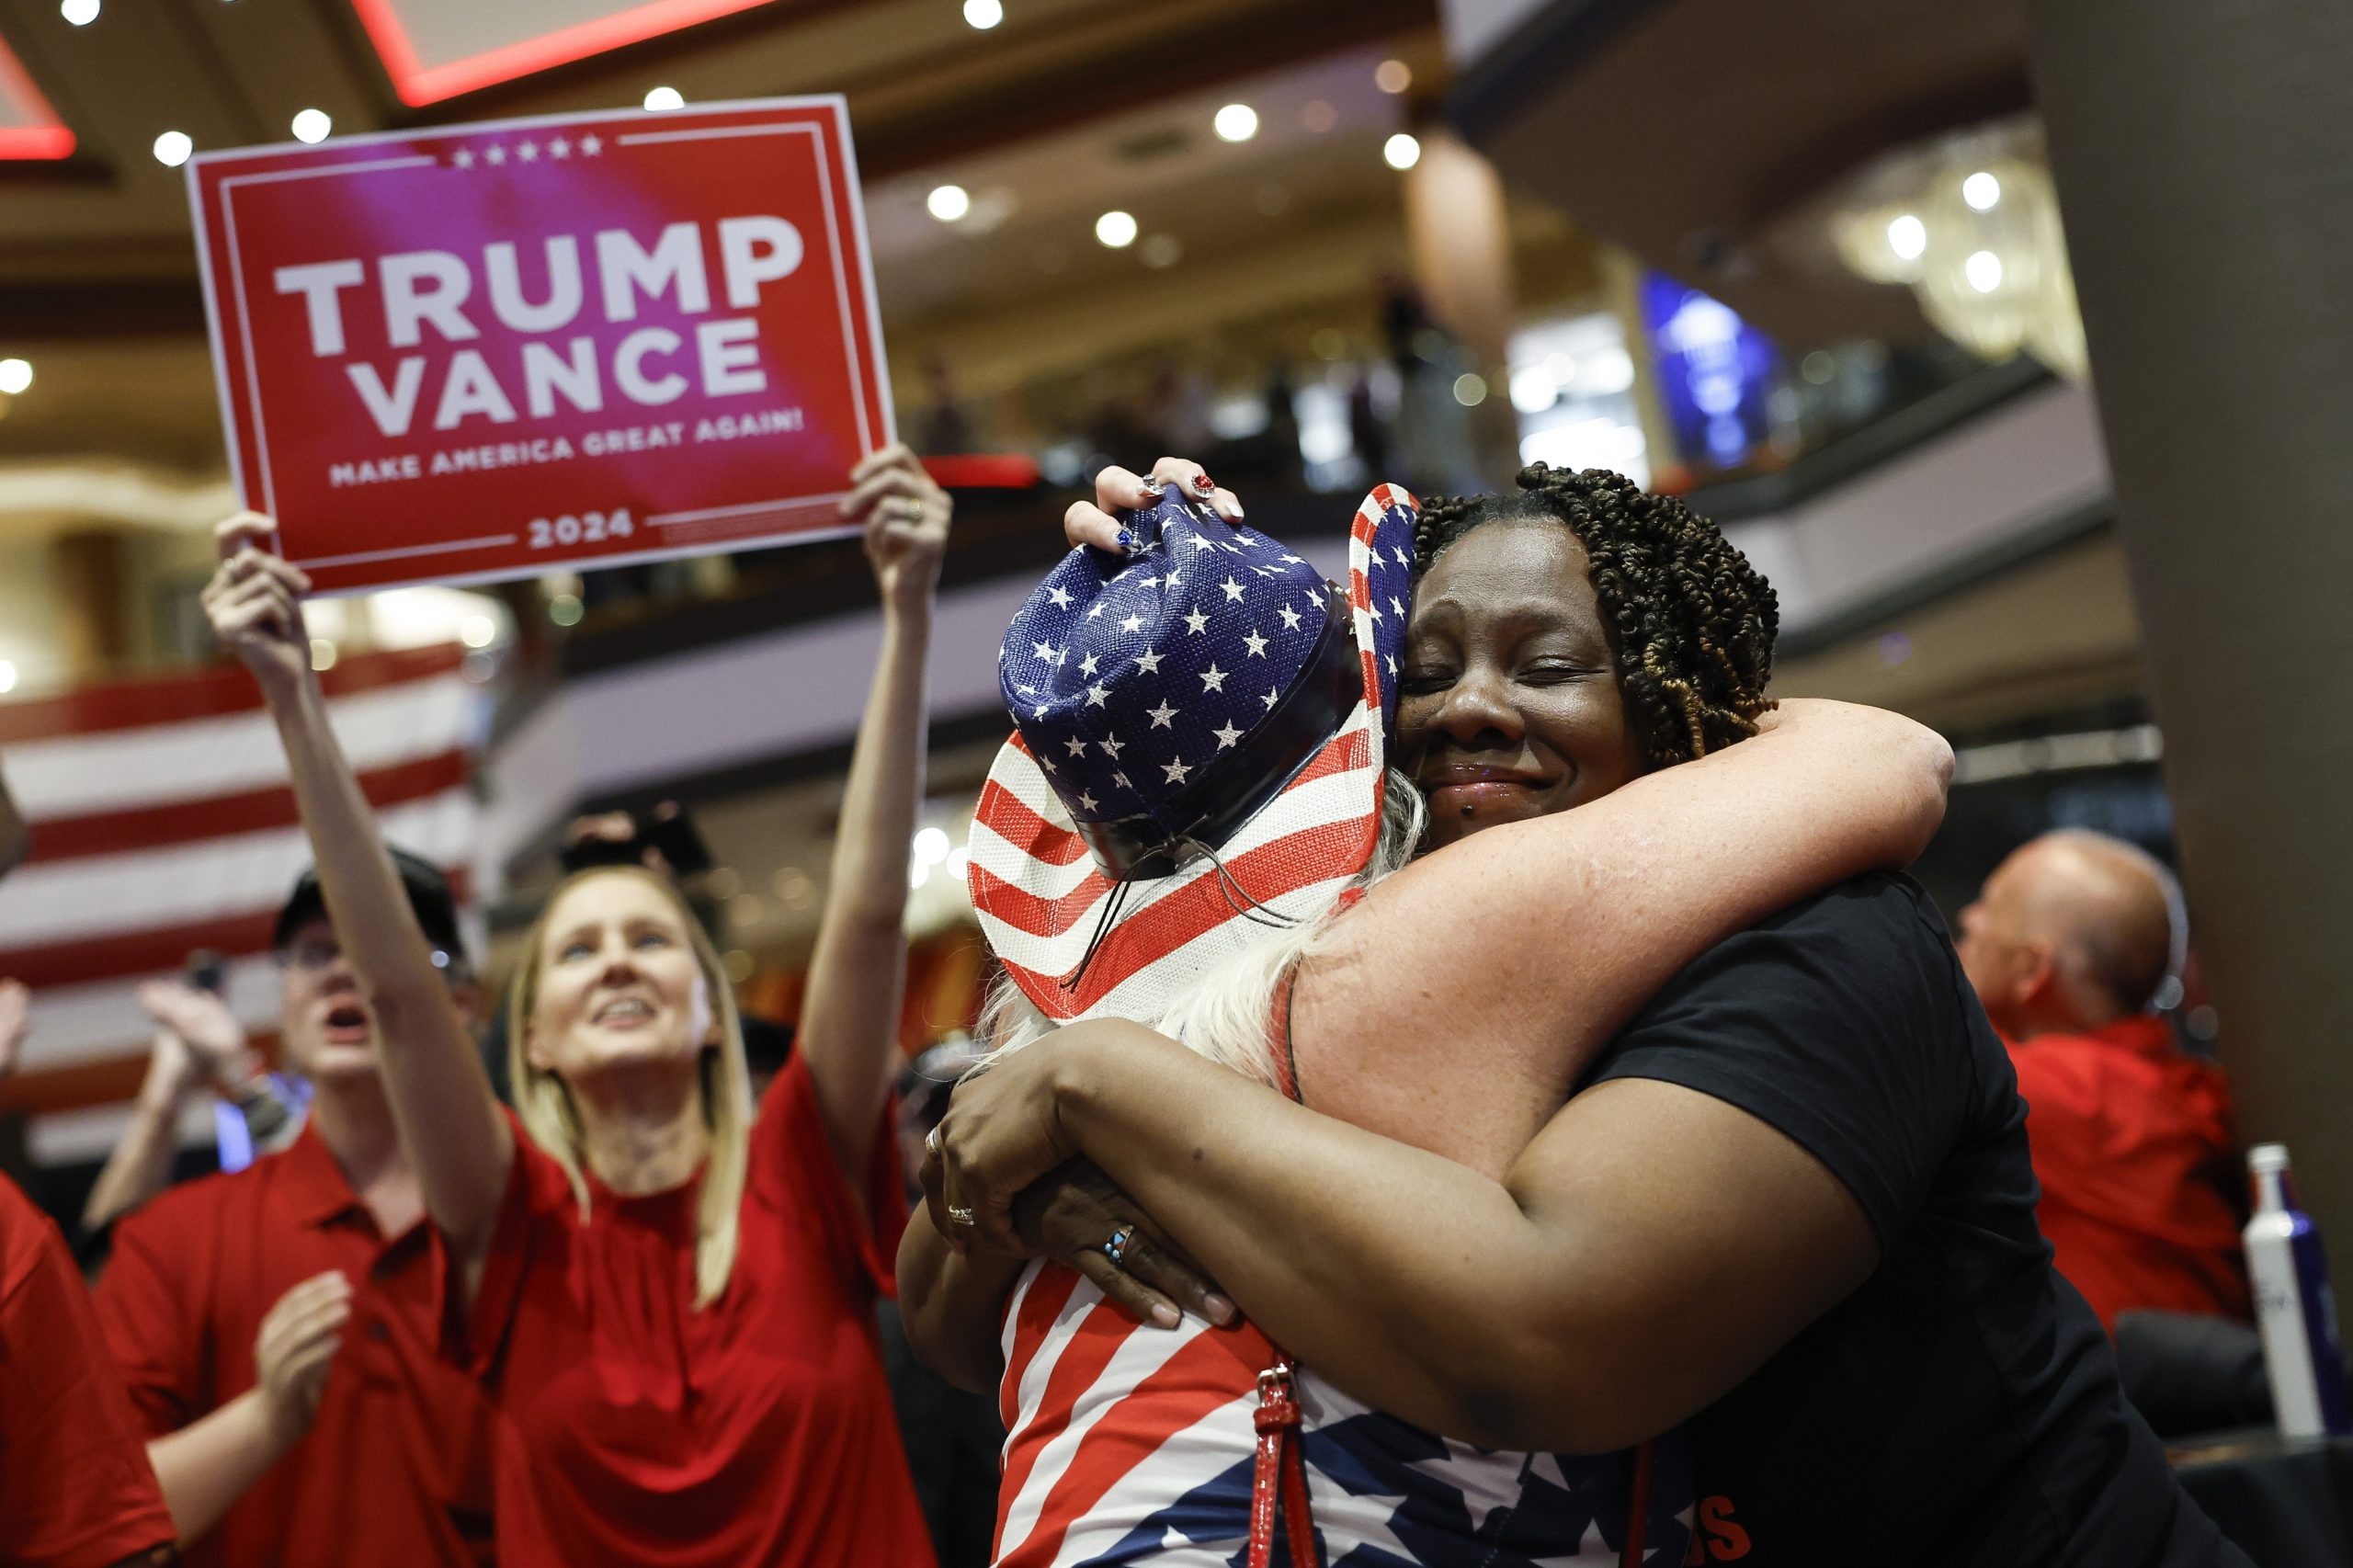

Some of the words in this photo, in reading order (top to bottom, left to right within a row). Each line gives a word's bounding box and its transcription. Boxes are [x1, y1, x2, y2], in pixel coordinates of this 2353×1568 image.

[274, 214, 805, 358] TRUMP
[347, 317, 767, 437] VANCE
[329, 455, 421, 487] MAKE
[429, 437, 574, 476] AMERICA
[582, 422, 684, 457] GREAT
[694, 407, 804, 443] AGAIN!
[527, 508, 634, 549] 2024
